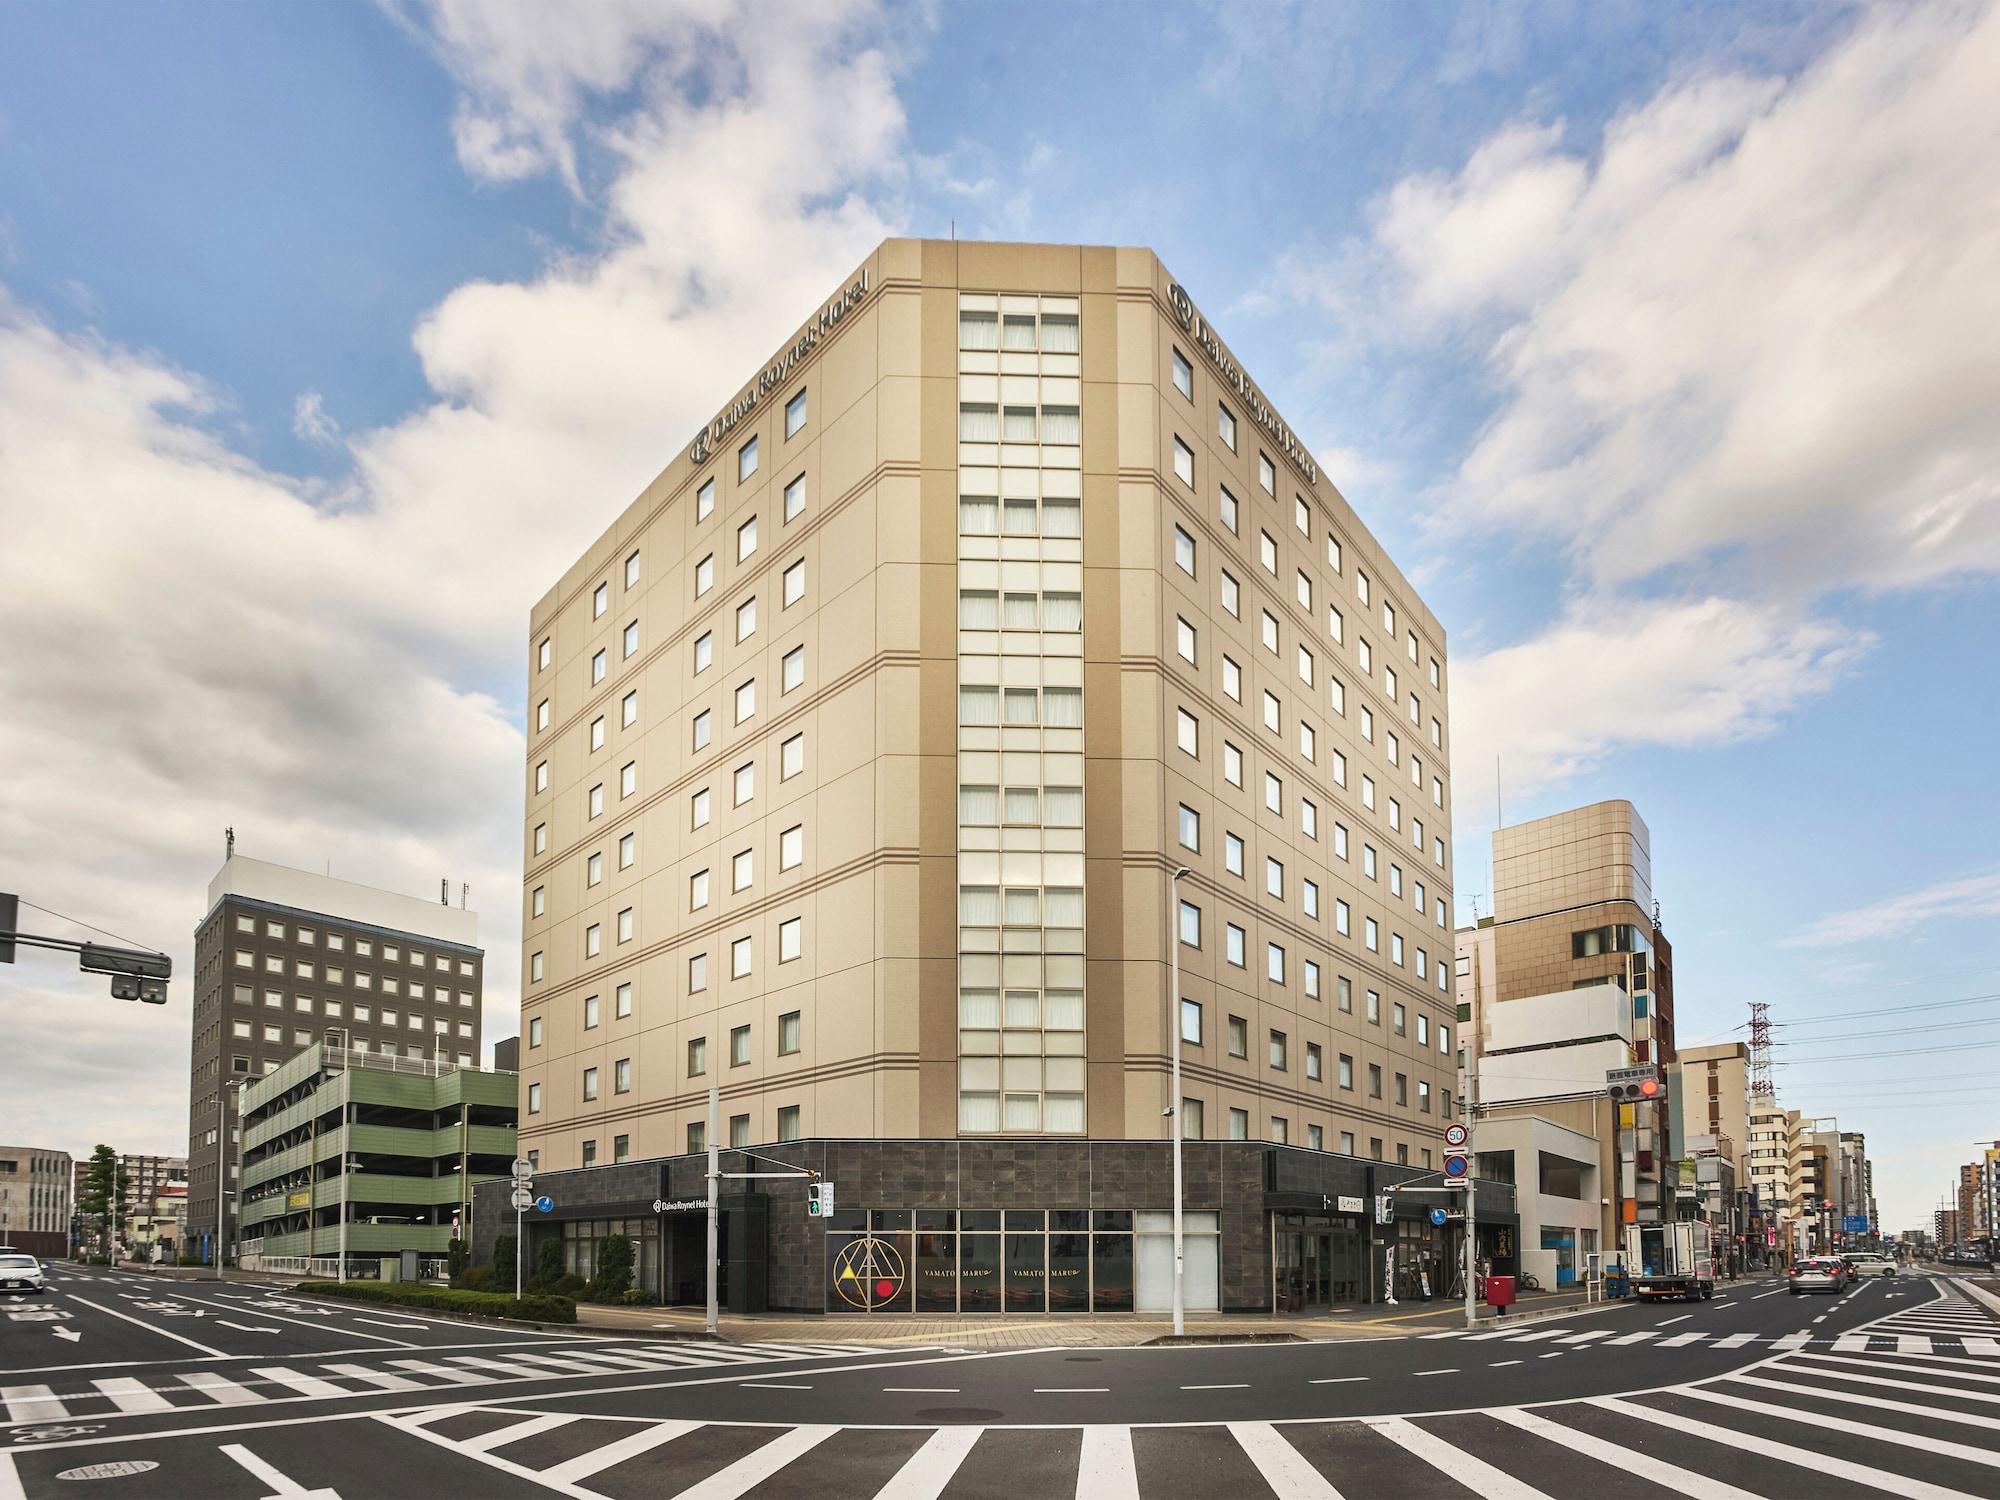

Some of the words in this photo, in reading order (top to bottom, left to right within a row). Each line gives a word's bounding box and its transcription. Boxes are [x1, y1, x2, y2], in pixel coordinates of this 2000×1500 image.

[714, 390, 757, 443] Daiwa
[758, 326, 818, 397] Roynet
[819, 268, 869, 337] Hotel
[1449, 1130, 1463, 1141] 50
[662, 1201, 677, 1211] Daiwa
[677, 1200, 696, 1212] Roynet
[924, 1269, 956, 1277] YAMATO
[1013, 1269, 1045, 1277] YAMATO
